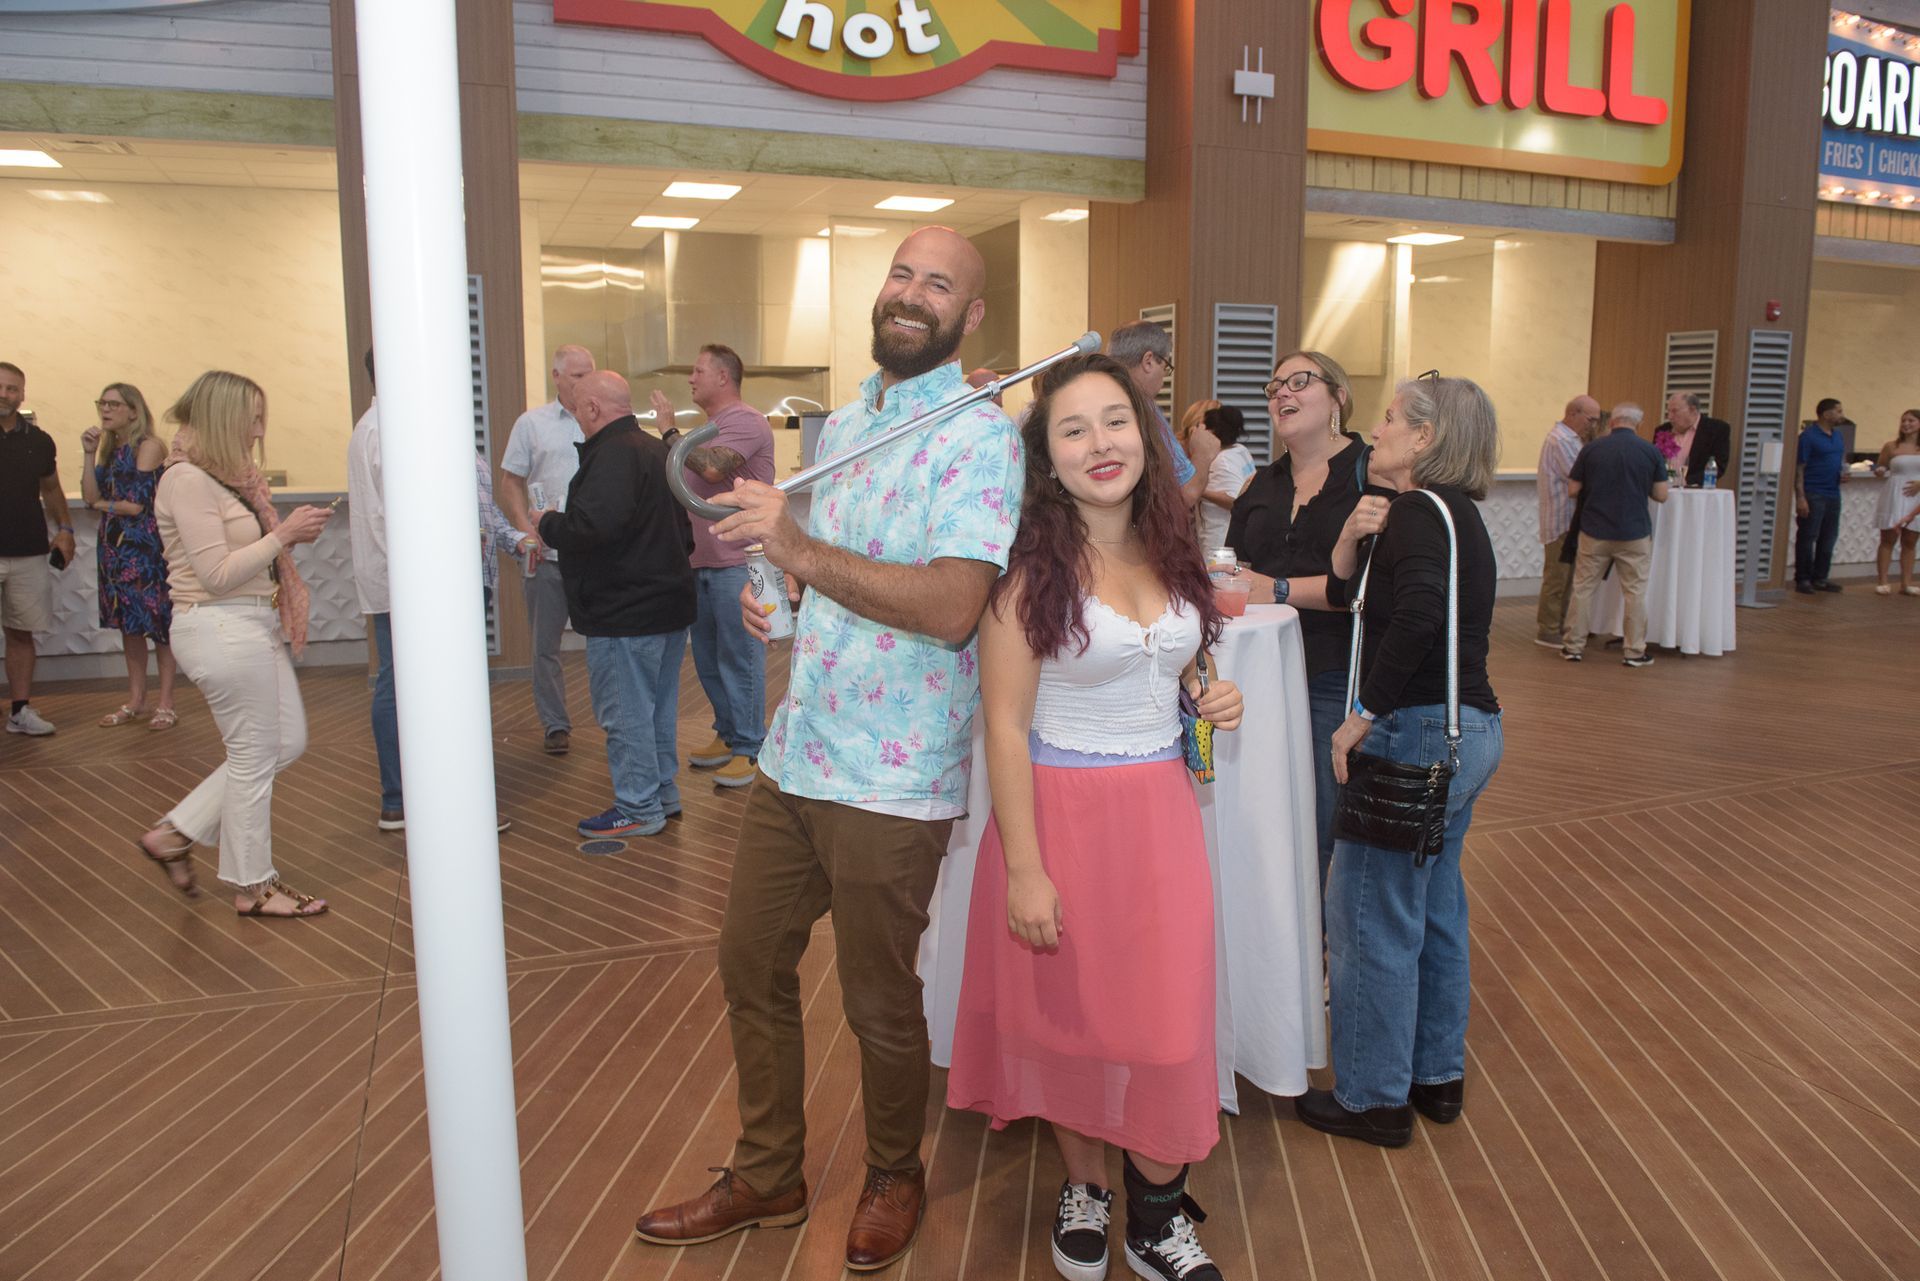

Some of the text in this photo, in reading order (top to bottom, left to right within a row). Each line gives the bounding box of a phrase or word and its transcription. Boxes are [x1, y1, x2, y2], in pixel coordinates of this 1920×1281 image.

[1316, 0, 1668, 125] GRILL
[1824, 141, 1920, 177] FRIES CHICK
